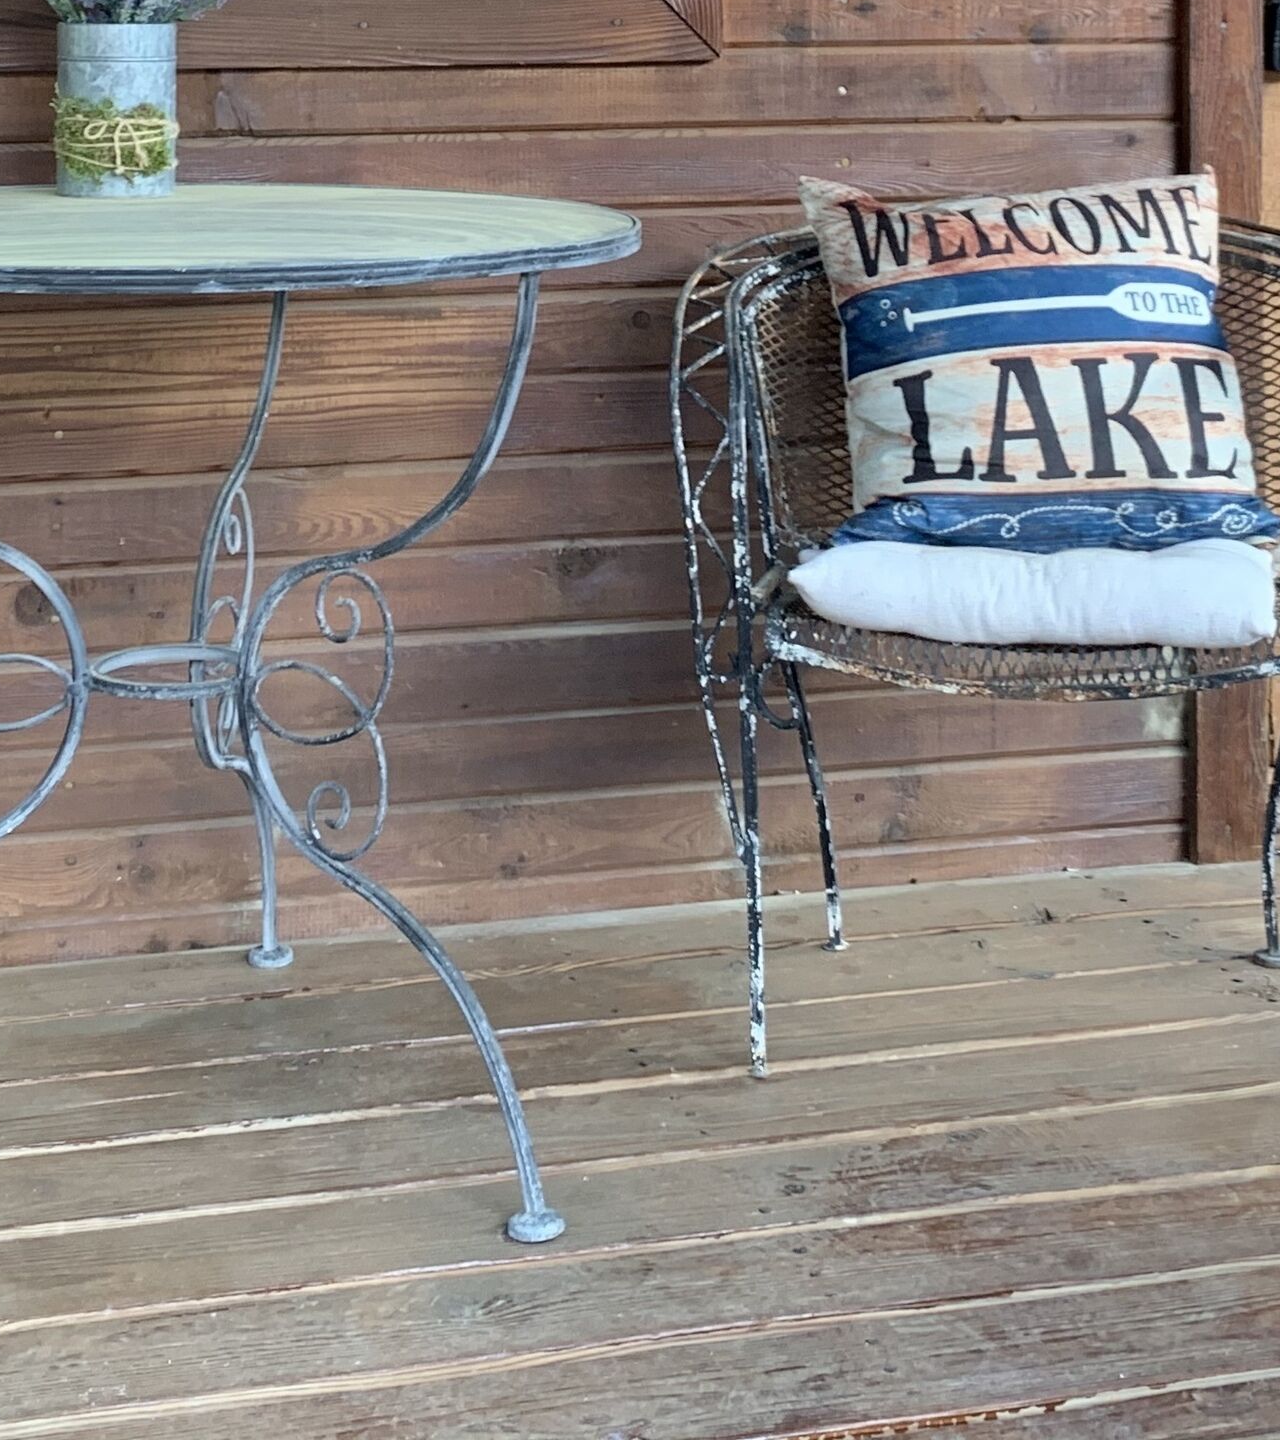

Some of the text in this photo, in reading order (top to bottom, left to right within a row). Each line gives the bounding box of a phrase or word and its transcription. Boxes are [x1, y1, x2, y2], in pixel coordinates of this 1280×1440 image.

[842, 185, 1214, 277] WELCOME
[1124, 291, 1203, 317] TO THE
[893, 352, 1240, 484] LAKE
